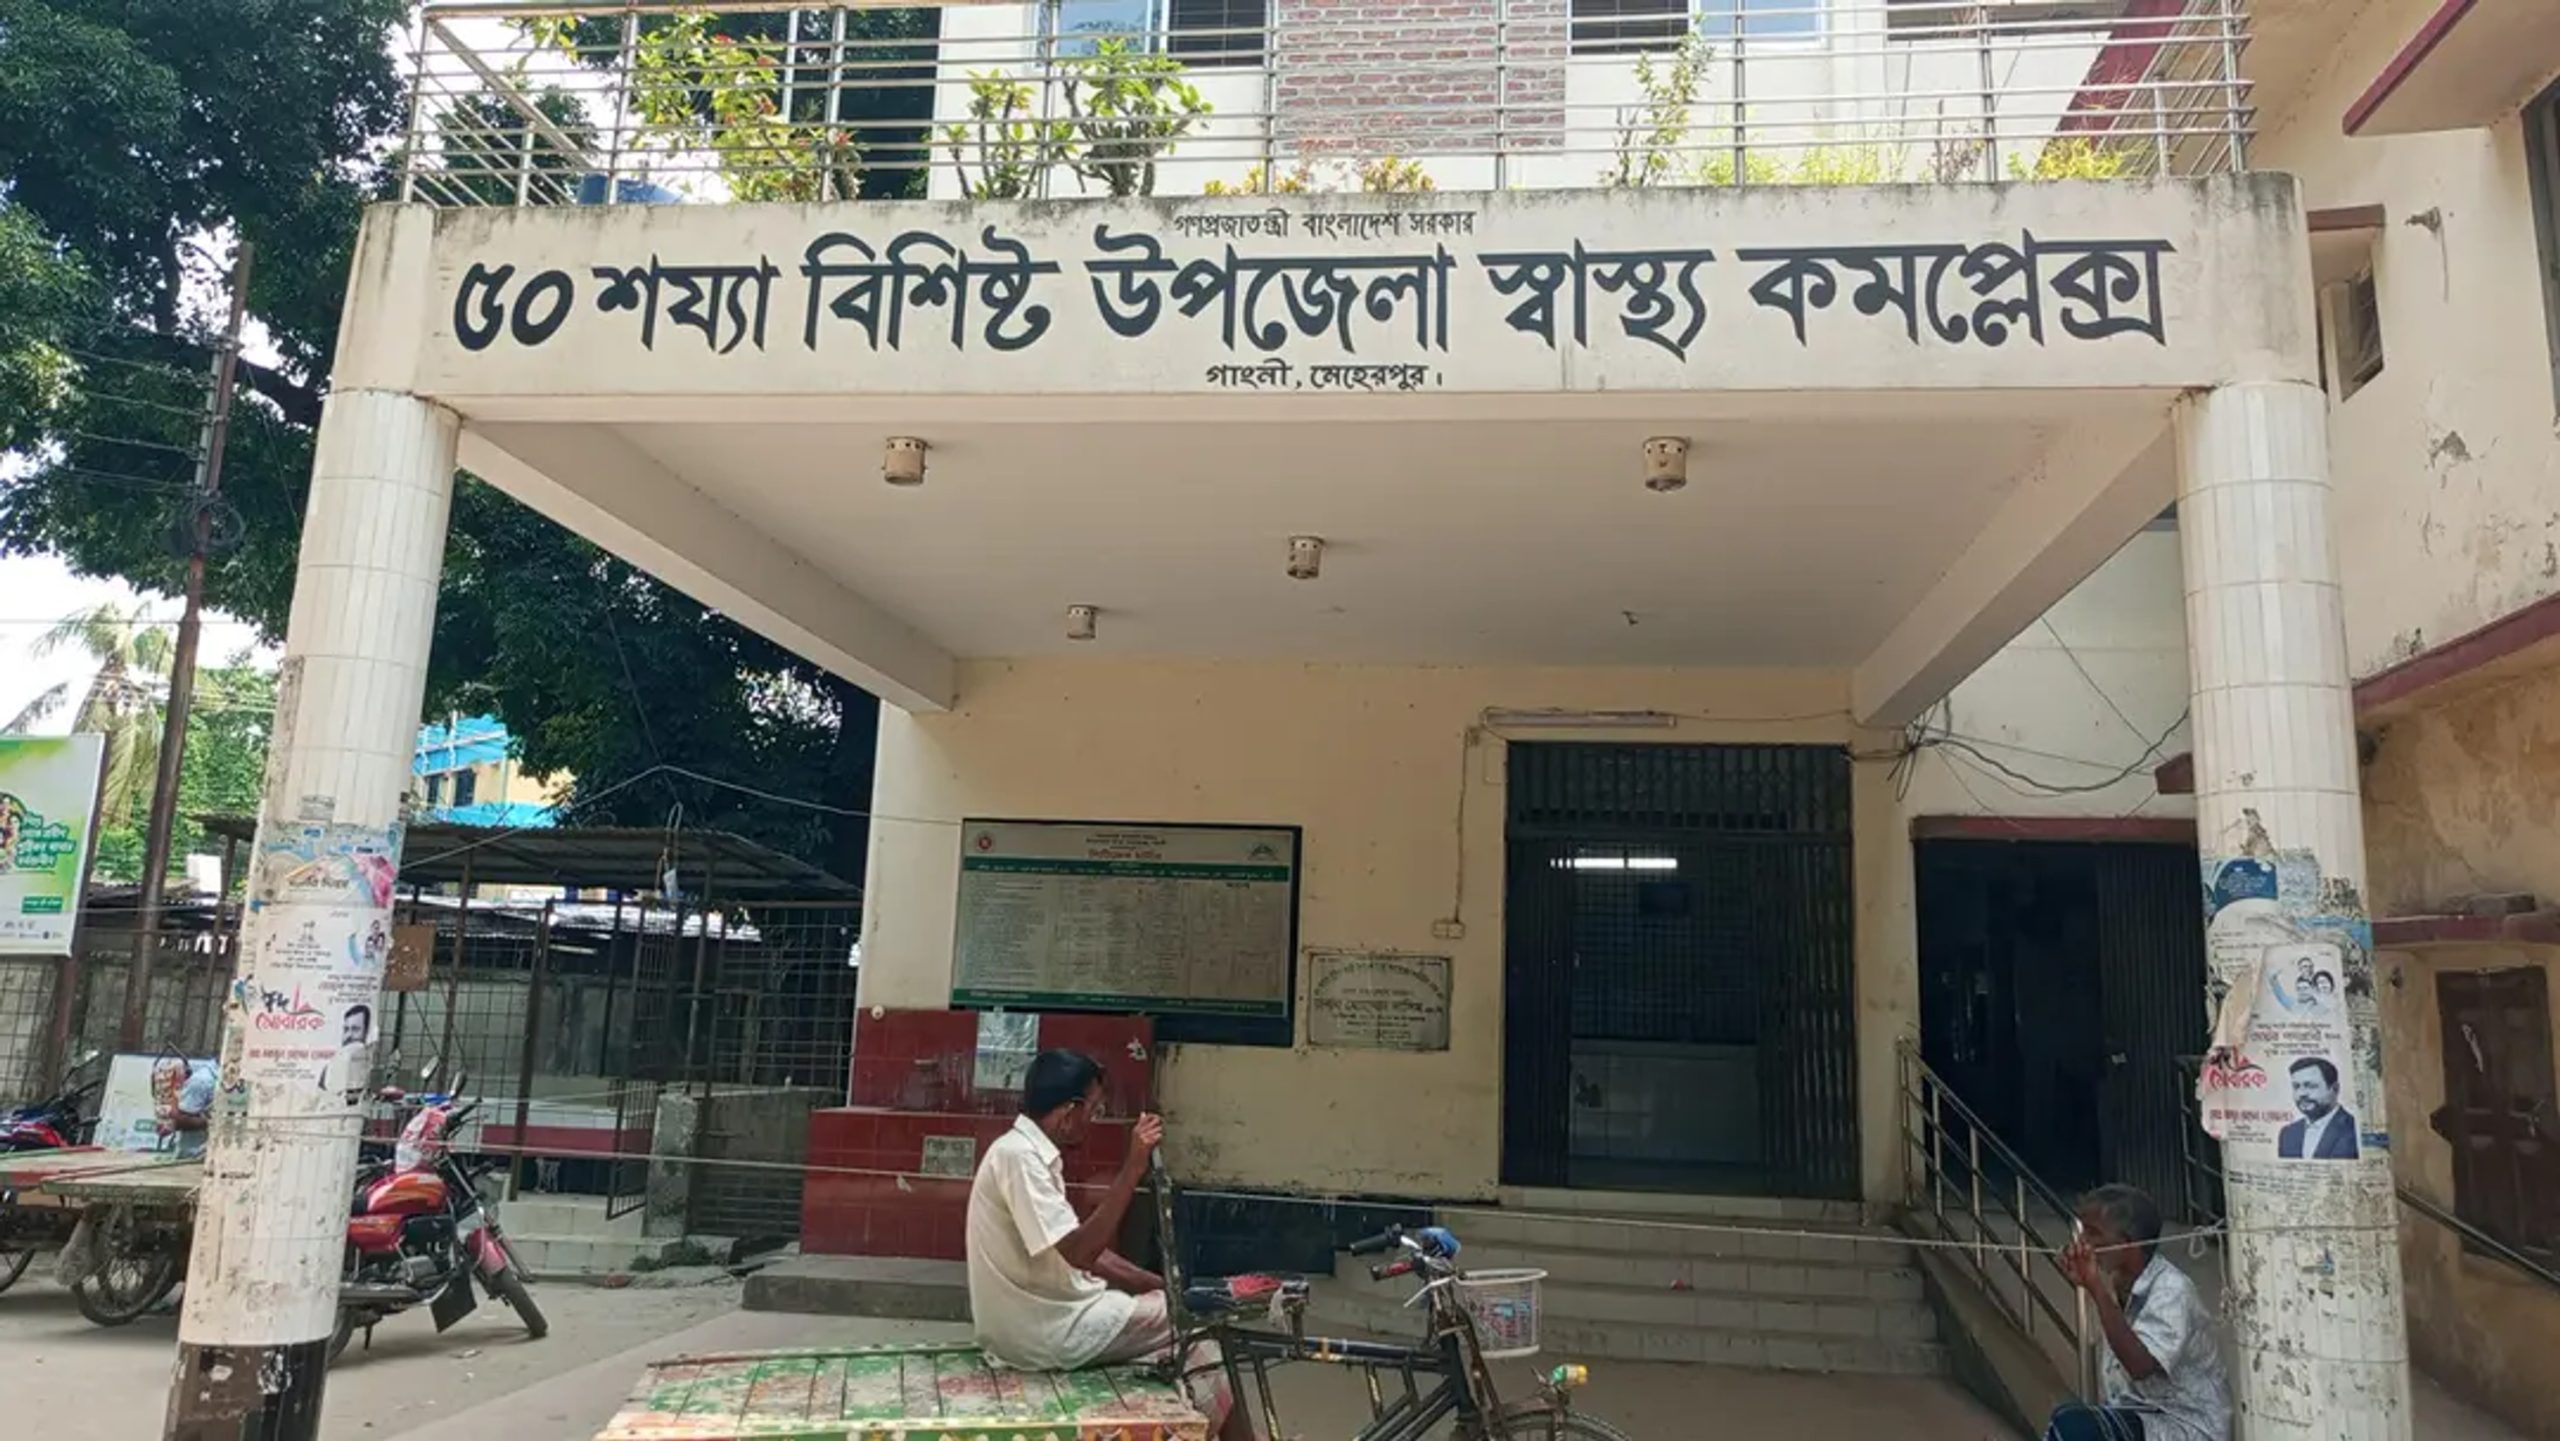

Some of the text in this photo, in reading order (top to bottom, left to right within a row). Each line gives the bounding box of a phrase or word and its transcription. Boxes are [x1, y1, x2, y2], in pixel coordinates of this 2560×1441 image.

[1174, 208, 1477, 240] গণপ্রজাতন্ত্রী বাংলাদেশ সরকার
[453, 224, 2178, 363] ৫০ শয্যা বিশিষ্ট উপজেলা স্বাস্থ্য কমপ্লেক্স
